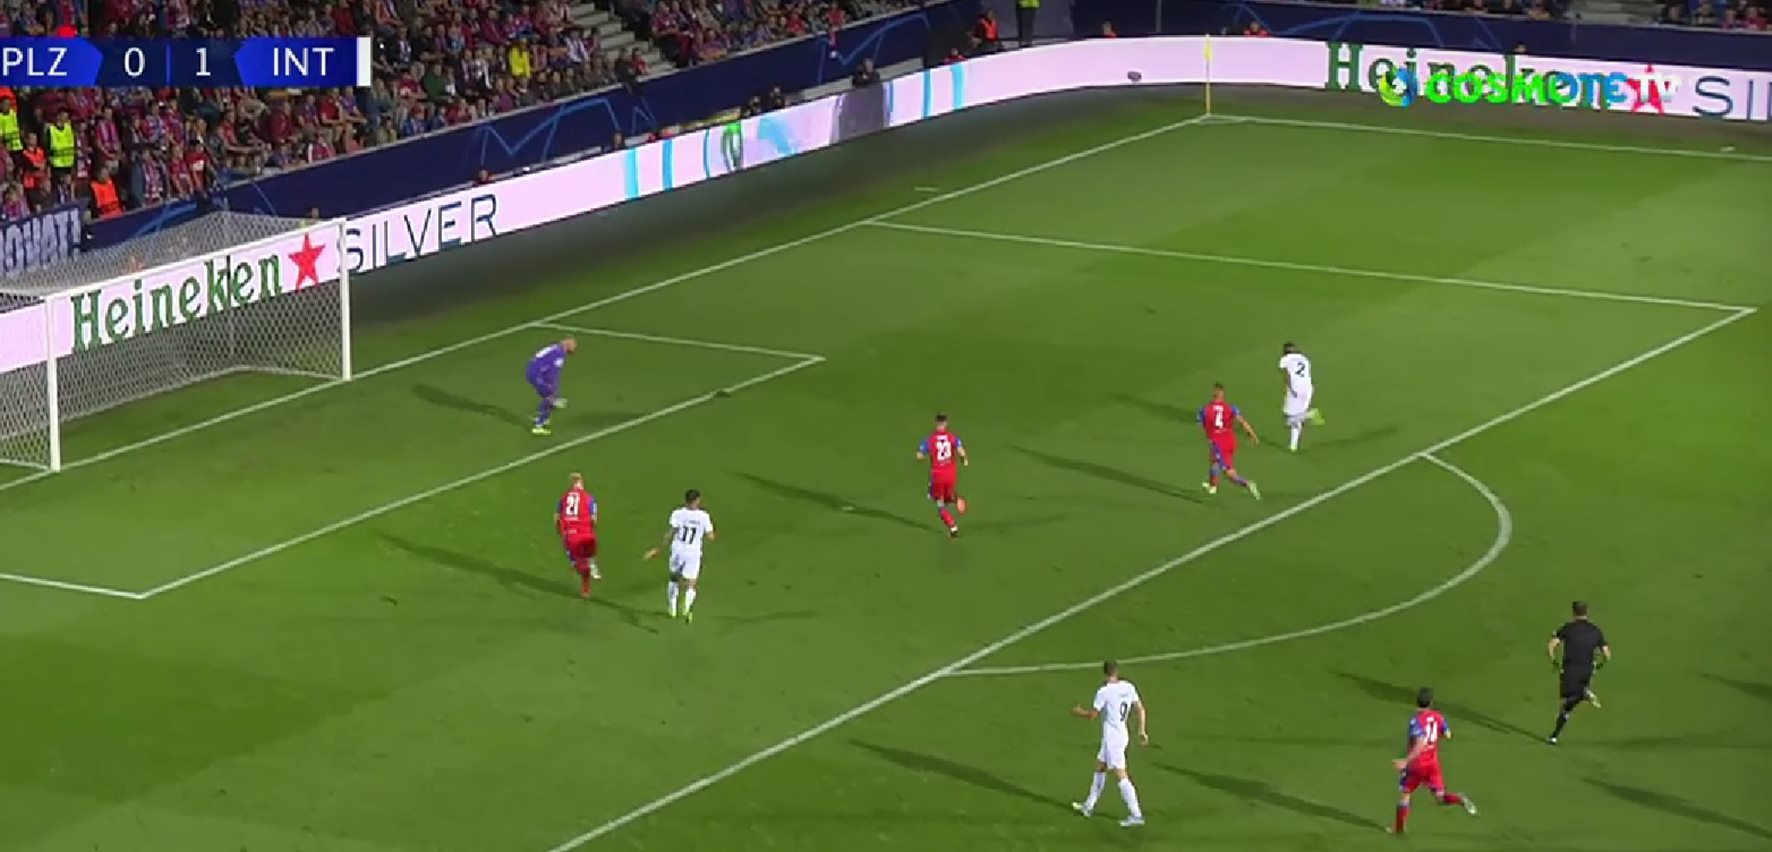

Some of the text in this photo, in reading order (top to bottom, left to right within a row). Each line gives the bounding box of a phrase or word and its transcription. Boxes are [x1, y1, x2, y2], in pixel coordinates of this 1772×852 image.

[1692, 74, 1772, 121] SI
[70, 193, 497, 354] Heineken SILVER
[1294, 361, 1305, 378] 2
[1119, 701, 1128, 722] 9
